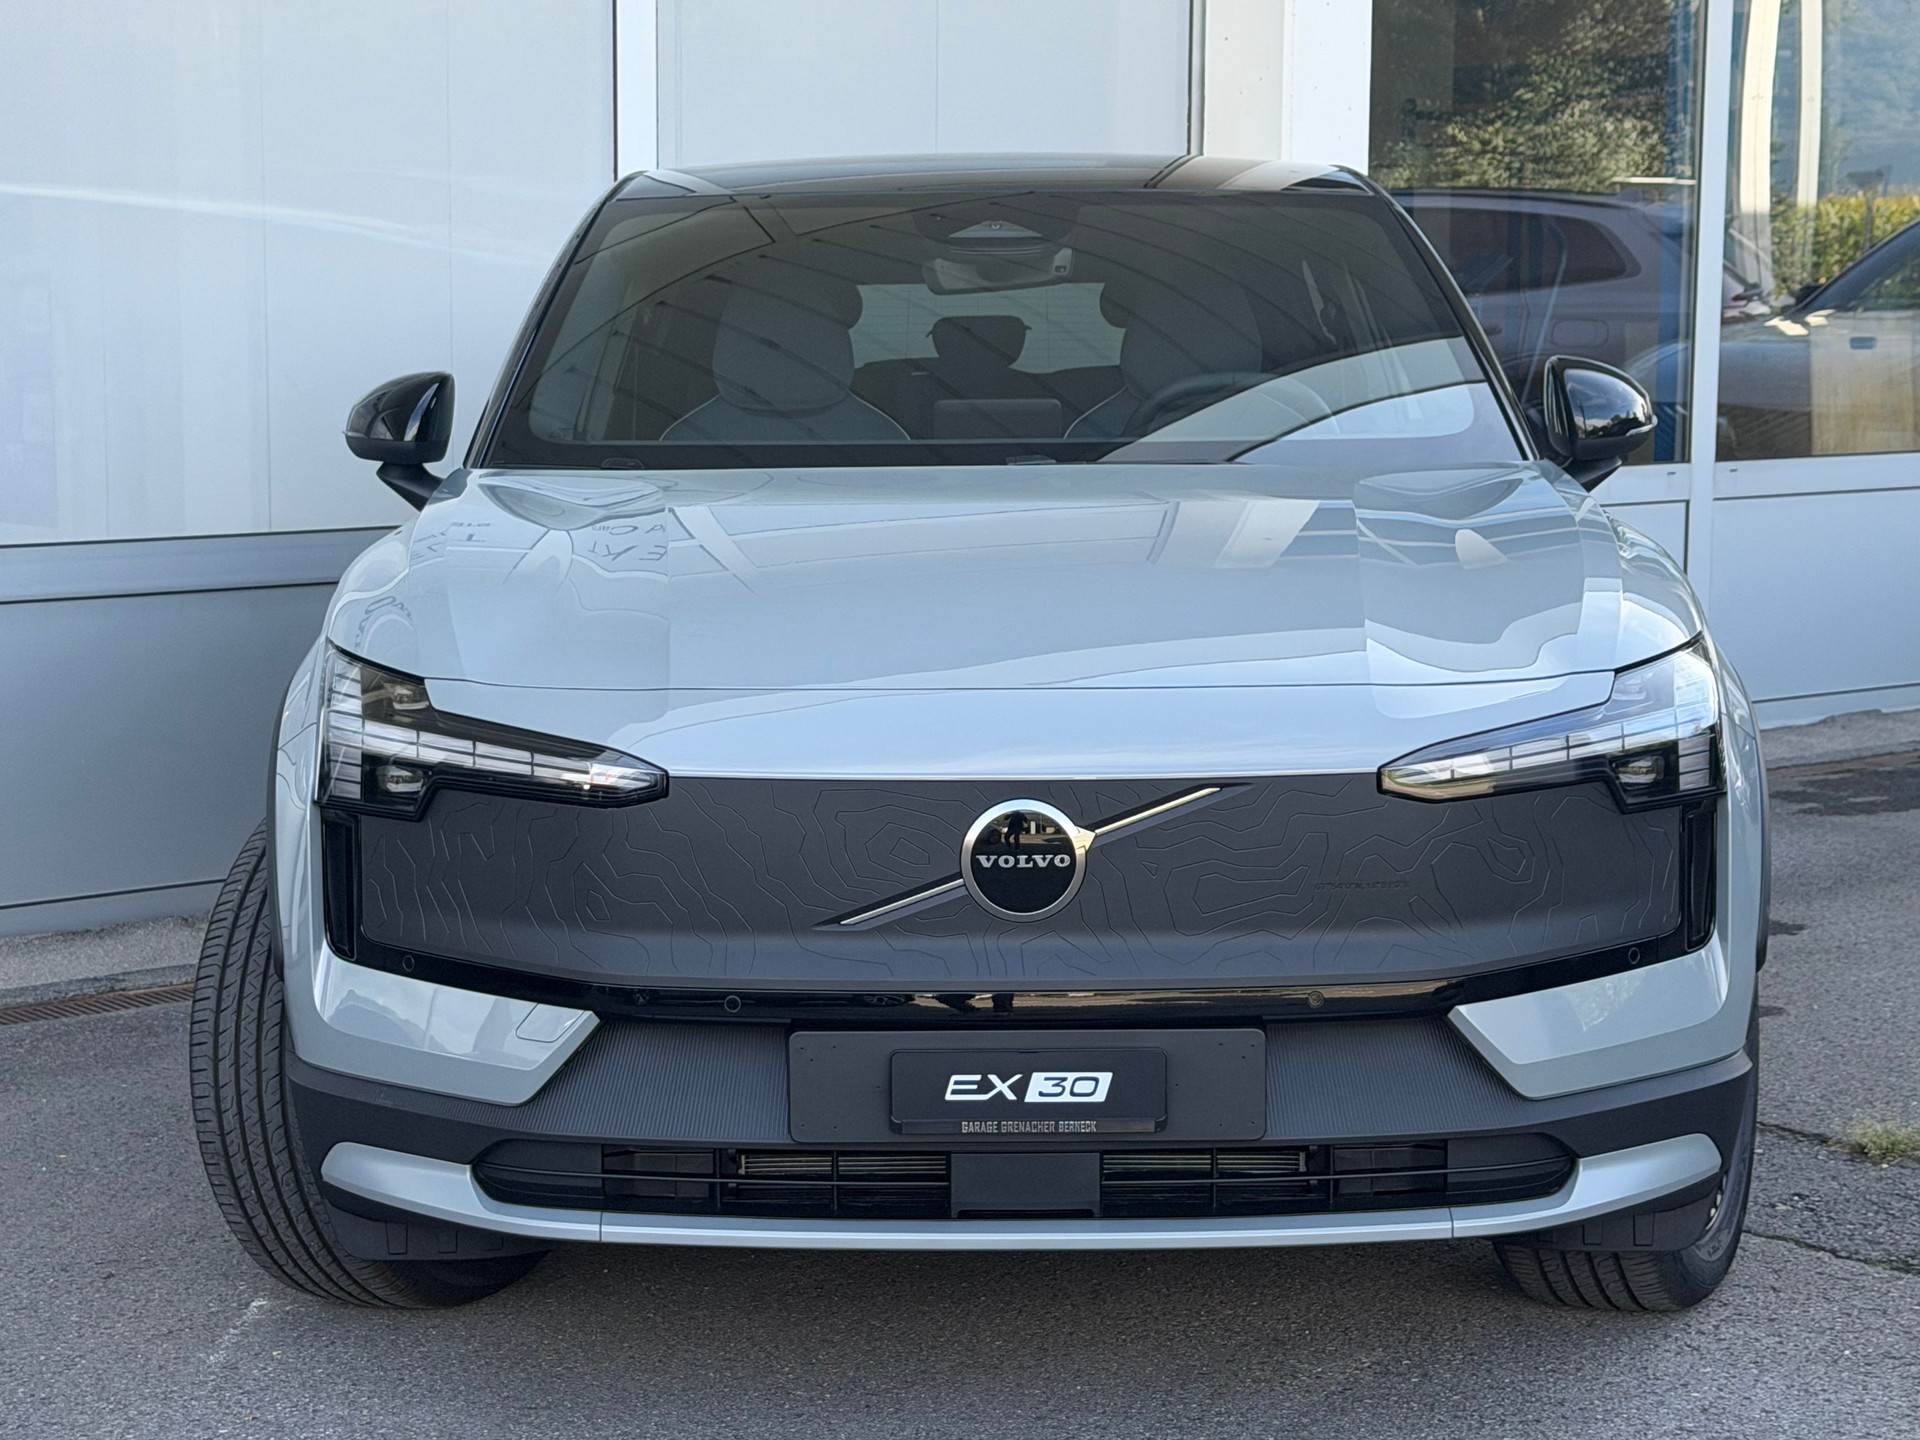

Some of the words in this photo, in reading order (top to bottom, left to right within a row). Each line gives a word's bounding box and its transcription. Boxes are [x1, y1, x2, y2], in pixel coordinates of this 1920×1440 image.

[976, 854, 1071, 868] VOLVO
[944, 1074, 1024, 1101] EX
[1037, 1075, 1101, 1098] 30
[961, 1121, 998, 1133] GARAGE
[1001, 1121, 1055, 1133] GRENACHER
[1058, 1120, 1097, 1132] BERNECK
